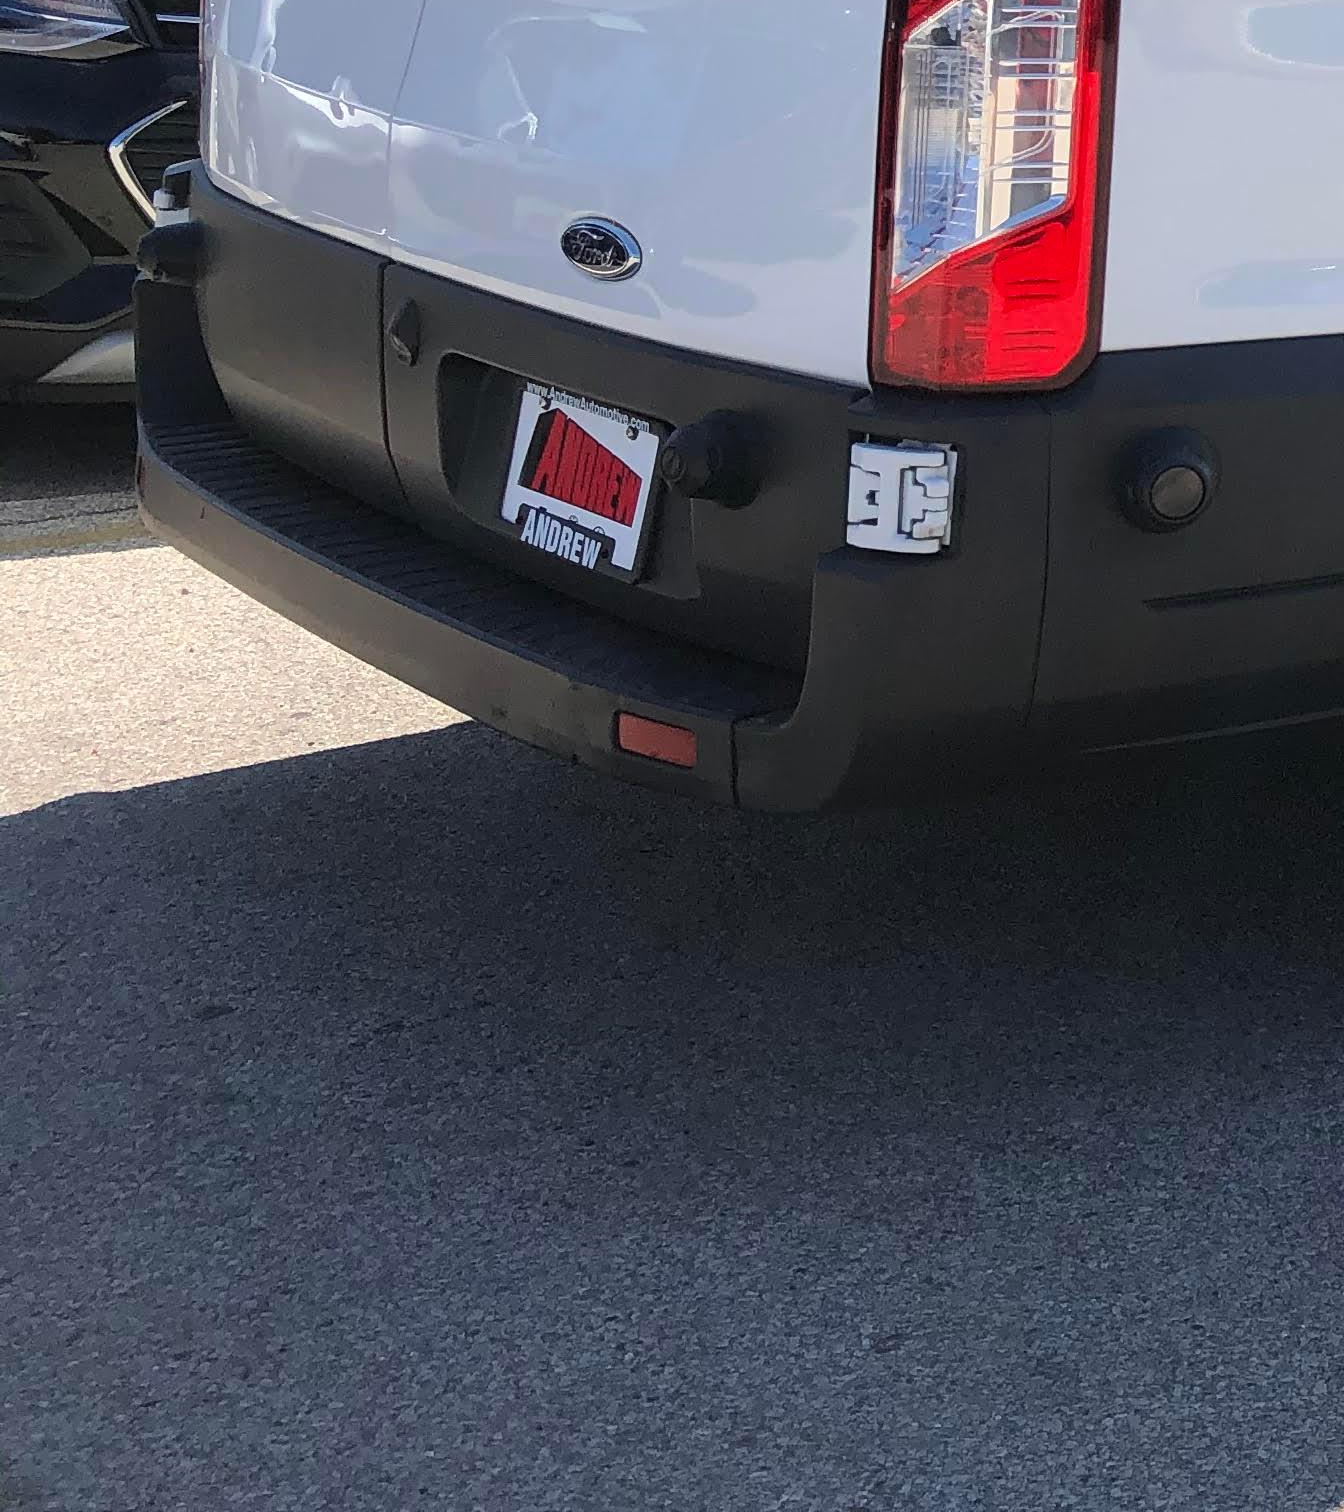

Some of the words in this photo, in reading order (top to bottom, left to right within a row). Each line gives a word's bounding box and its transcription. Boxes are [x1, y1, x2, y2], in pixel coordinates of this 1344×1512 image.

[526, 381, 650, 433] www.AndrewAutomotive.com
[531, 407, 643, 529] ANDREW
[521, 508, 602, 570] ANDREW
